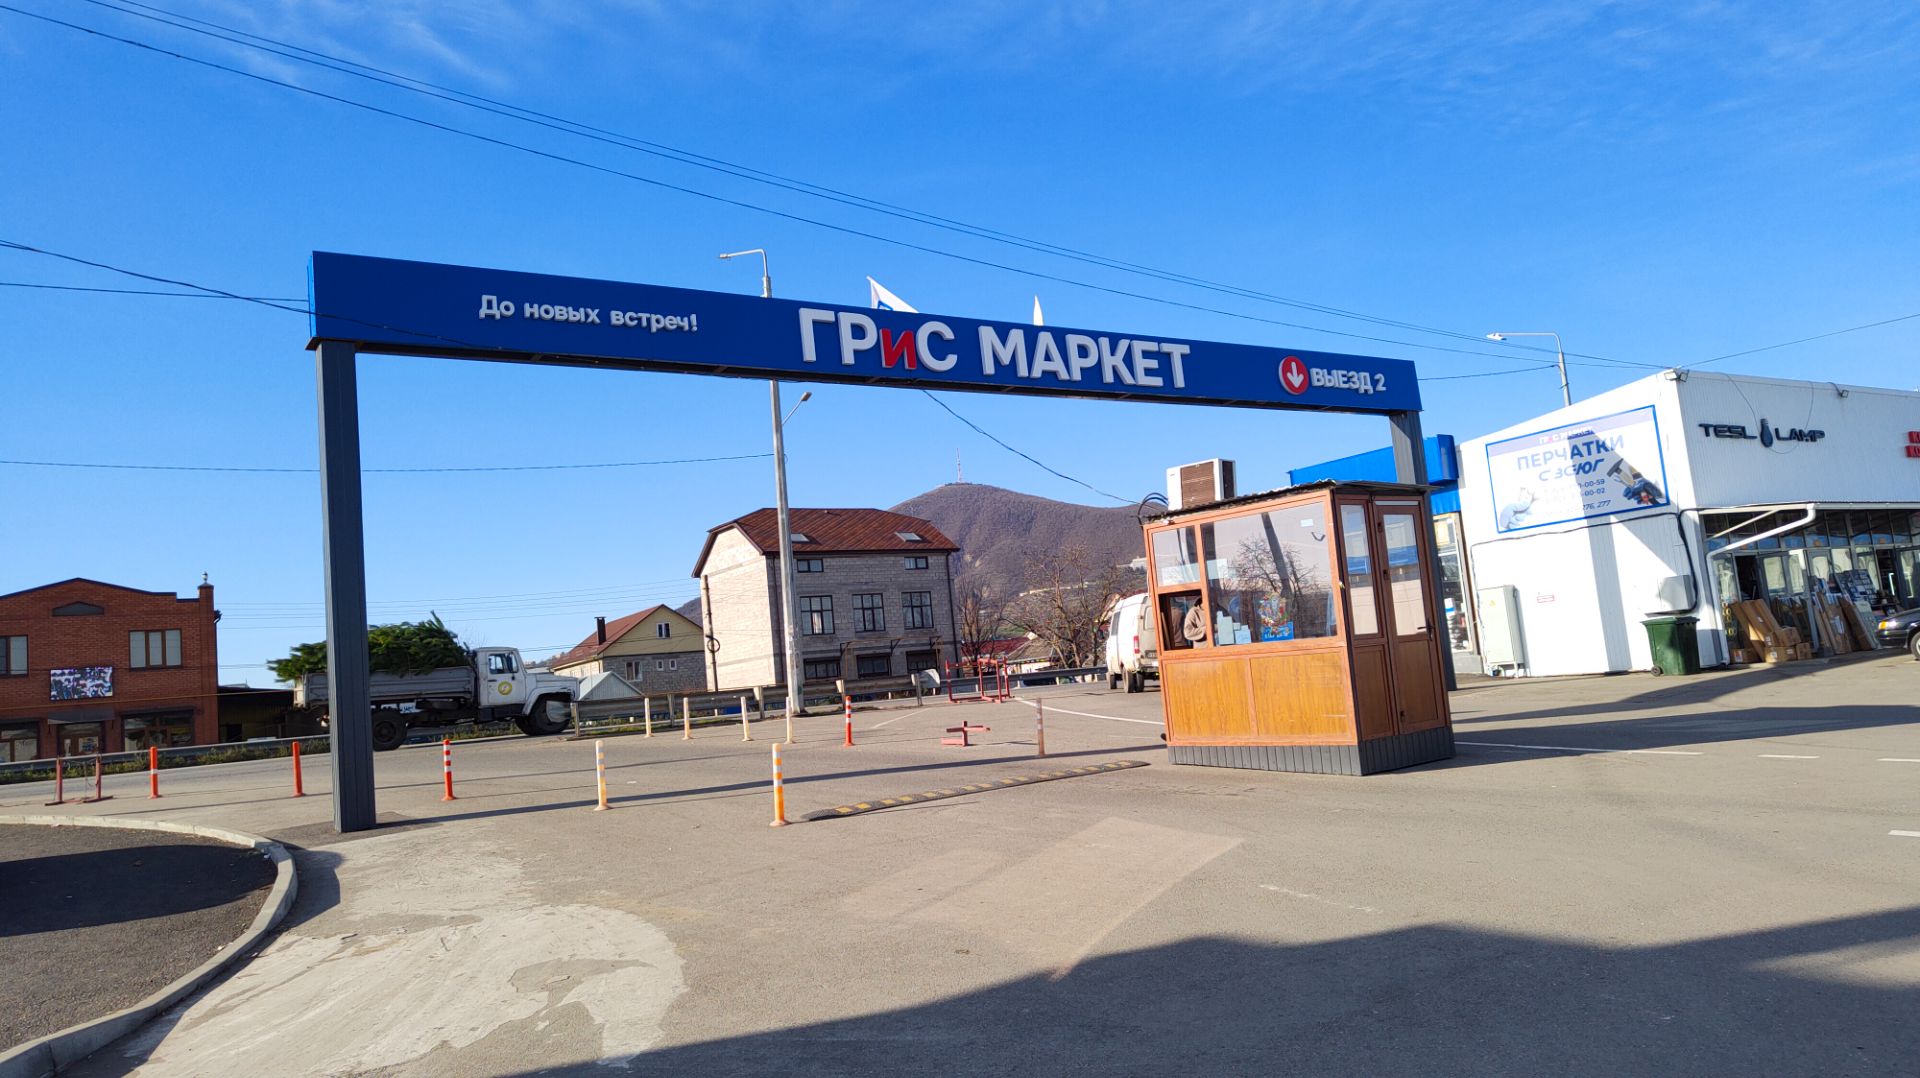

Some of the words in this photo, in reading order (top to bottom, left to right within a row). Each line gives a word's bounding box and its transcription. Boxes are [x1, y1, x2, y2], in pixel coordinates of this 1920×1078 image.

[479, 294, 515, 320] До
[524, 302, 600, 324] новых
[610, 309, 699, 333] встреч!
[977, 324, 1191, 389] МАРКЕТ
[1310, 367, 1374, 395] ВЫЕЗД
[1374, 373, 1387, 392] 2
[1517, 434, 1625, 471] ПЕРЧАТКИ
